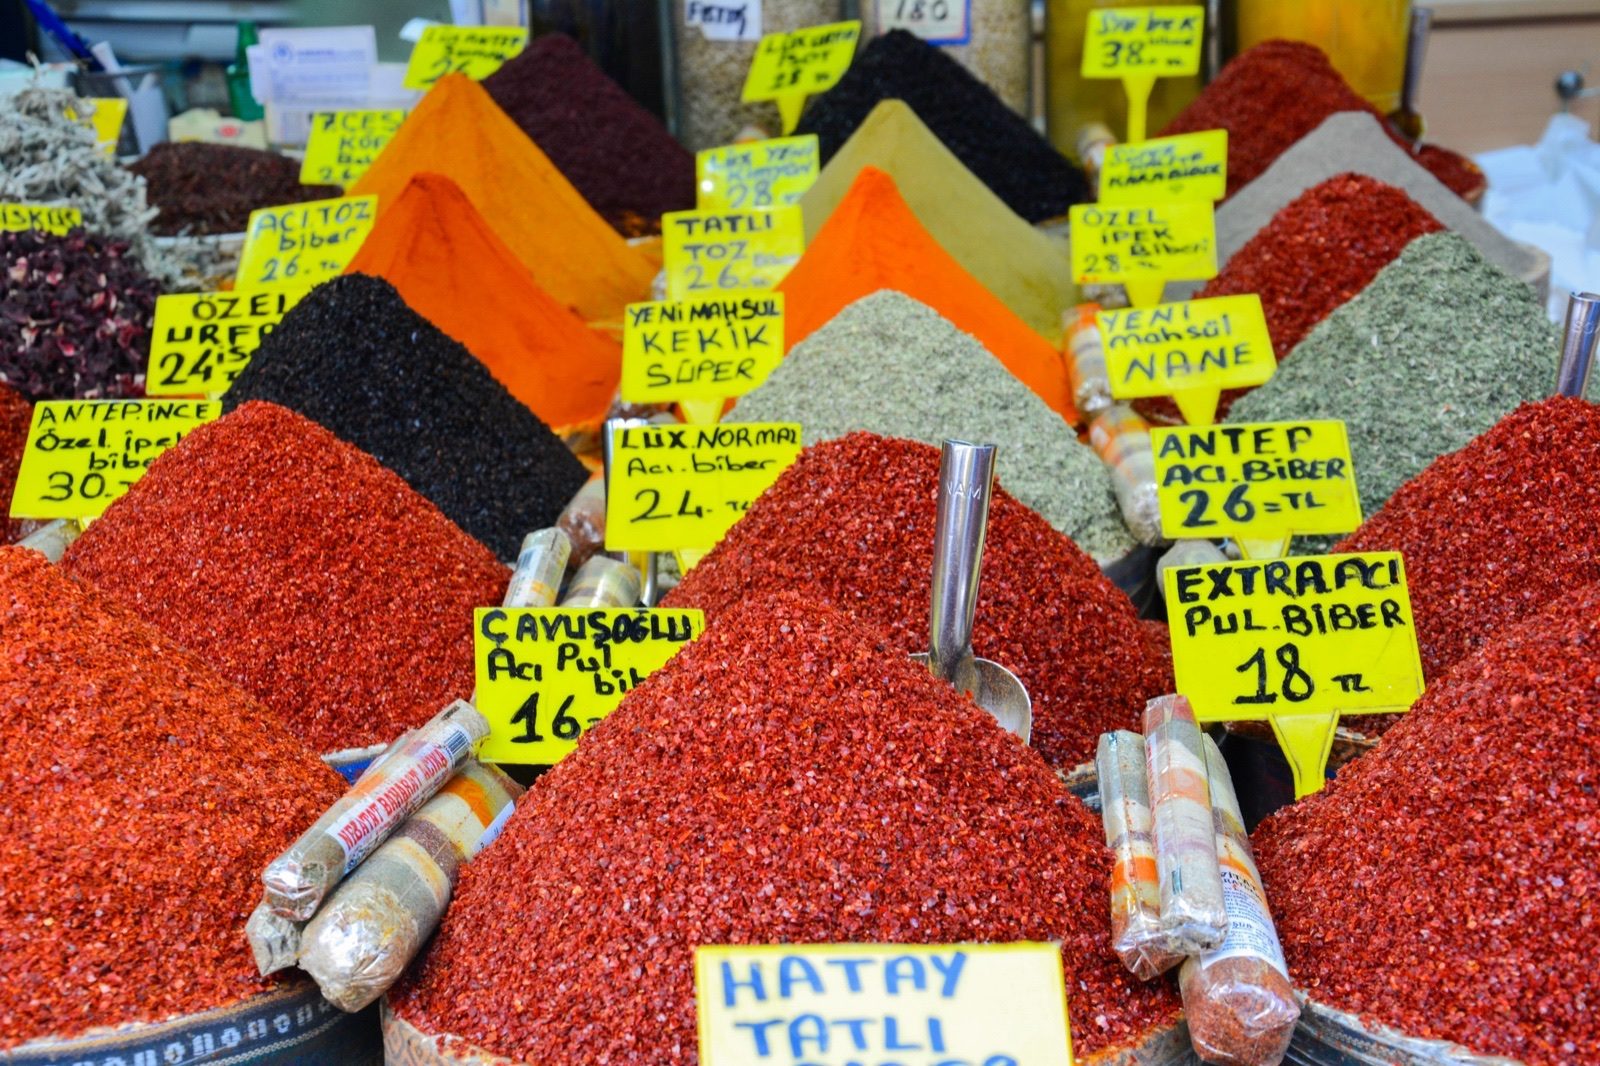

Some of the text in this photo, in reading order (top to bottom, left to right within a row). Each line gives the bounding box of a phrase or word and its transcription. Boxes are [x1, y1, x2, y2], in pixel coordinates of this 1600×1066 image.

[676, 213, 772, 236] TATLI
[1083, 204, 1169, 227] ÖZEL
[279, 227, 357, 251] biber
[683, 240, 748, 261] TOZ
[1109, 313, 1232, 349] mahsül
[159, 348, 213, 386] 24
[646, 357, 756, 388] SÜPER
[1123, 342, 1255, 384] NANE
[1159, 426, 1313, 459] ANTEP
[556, 642, 612, 672] Pul
[1231, 642, 1374, 705] 18 TL
[509, 691, 582, 744] 16
[720, 951, 968, 1009] HATAY
[733, 1013, 947, 1059] TATLI
